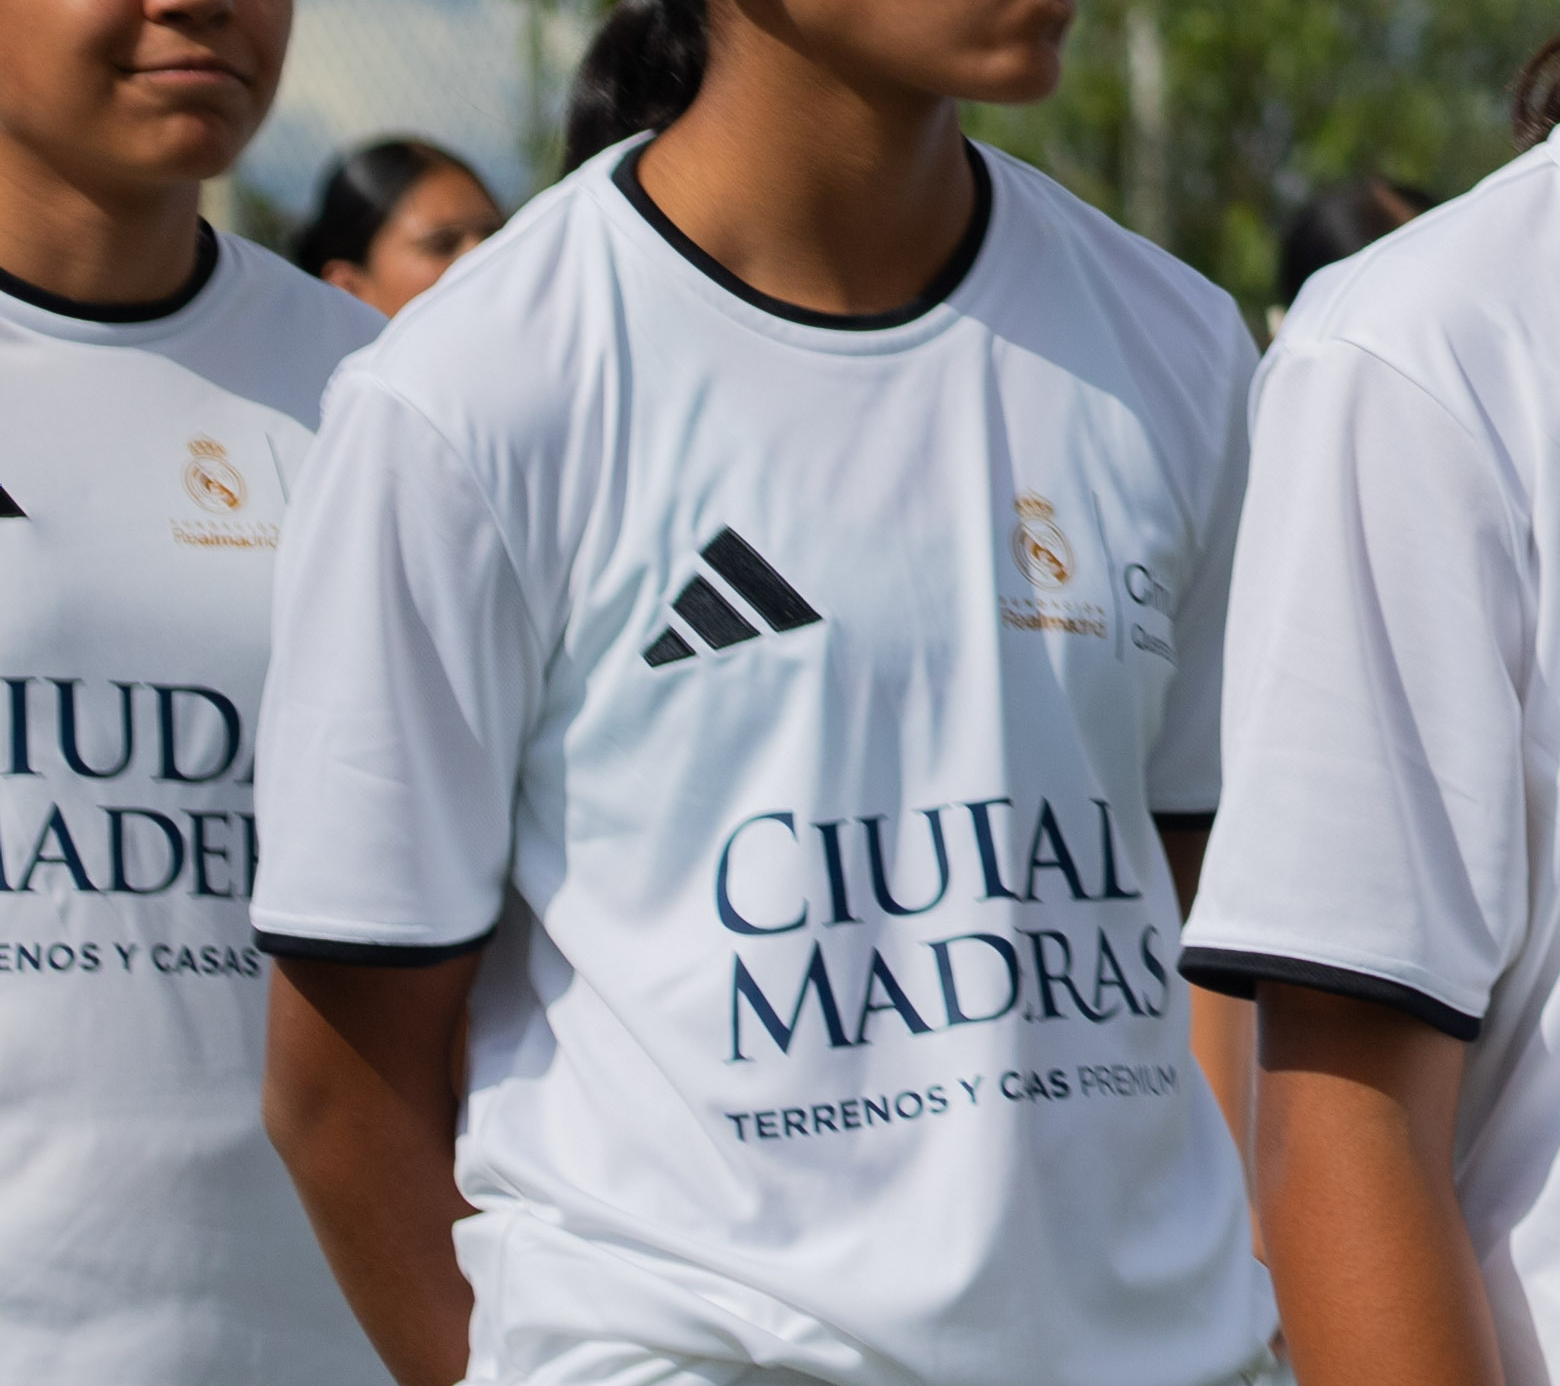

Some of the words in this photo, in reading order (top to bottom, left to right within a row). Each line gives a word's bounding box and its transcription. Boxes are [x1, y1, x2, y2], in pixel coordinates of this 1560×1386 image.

[0, 675, 254, 784] IUD
[112, 941, 138, 974] Y
[151, 942, 263, 980] CASAS
[725, 1084, 950, 1143] TERRENOS
[957, 1074, 984, 1106] Y
